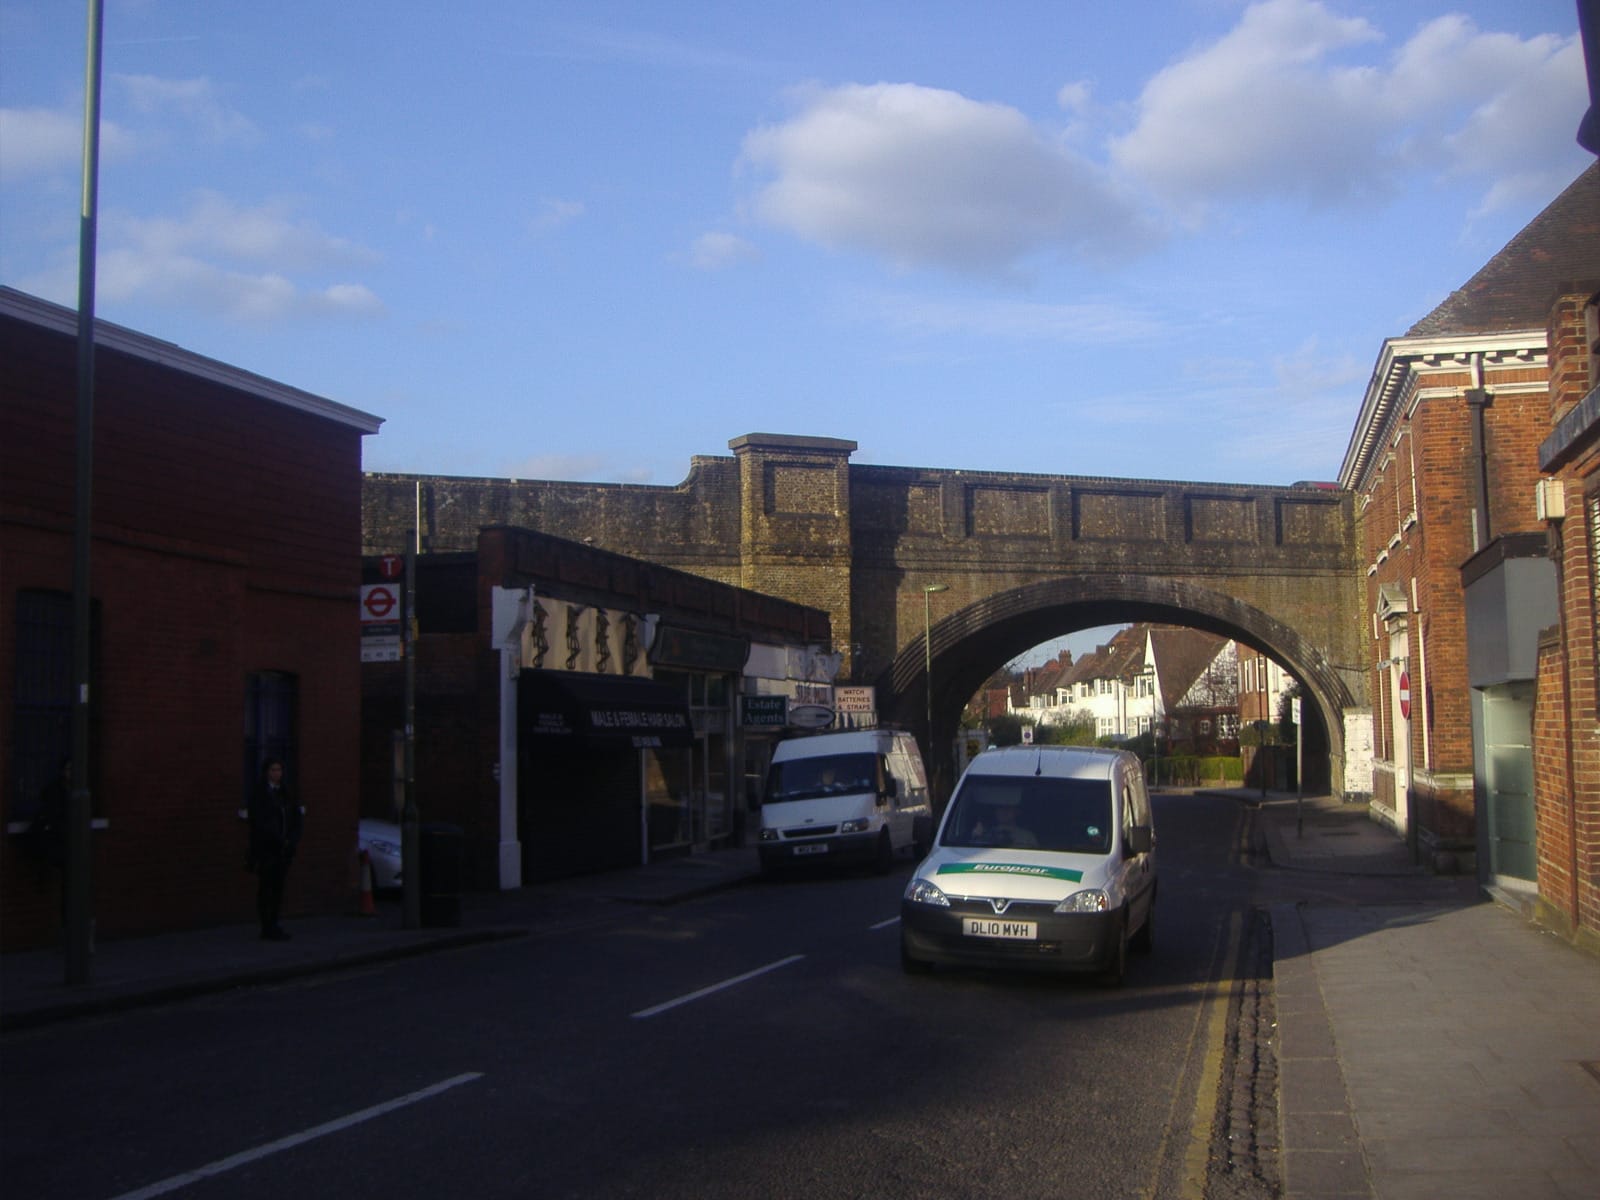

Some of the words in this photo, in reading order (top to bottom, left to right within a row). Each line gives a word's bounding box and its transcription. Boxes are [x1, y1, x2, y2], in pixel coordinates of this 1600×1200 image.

[748, 699, 781, 709] Estate
[591, 712, 614, 727] MALE
[973, 863, 1049, 874] Europcar
[971, 921, 999, 935] DL10
[1003, 923, 1029, 937] MVH
